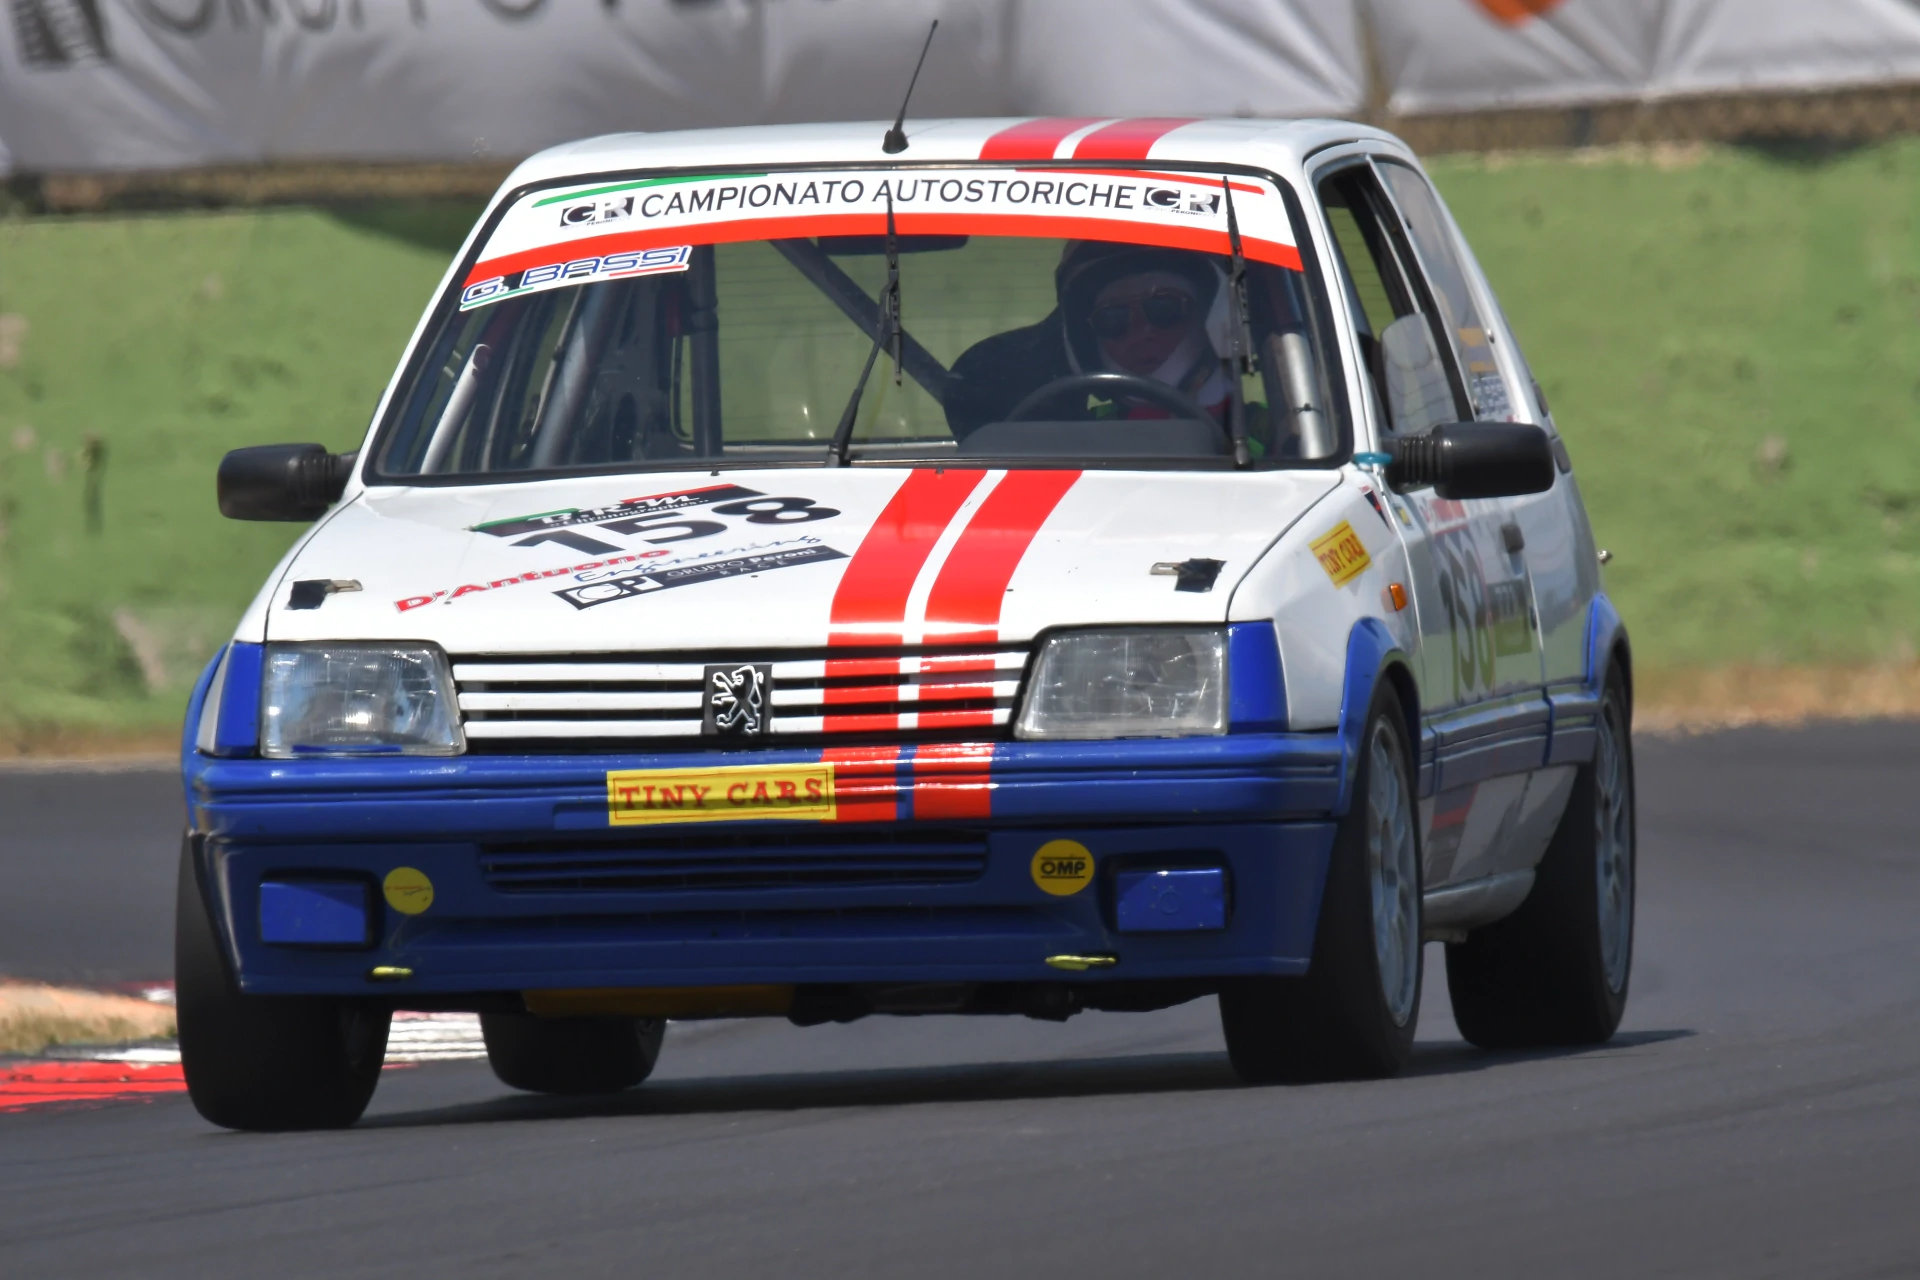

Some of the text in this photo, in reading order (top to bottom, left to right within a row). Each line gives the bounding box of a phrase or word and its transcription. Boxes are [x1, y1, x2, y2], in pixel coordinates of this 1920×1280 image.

[641, 179, 1138, 218] CAMPIONATO AUTOSTORICHE
[521, 246, 690, 287] BASSI
[509, 496, 842, 557] 158
[573, 535, 822, 583] Engineering
[665, 548, 817, 579] GRUPPO Peroni
[718, 559, 790, 577] RACE
[394, 549, 674, 613] D'Antuono
[618, 777, 823, 811] TINY CARS
[1040, 860, 1087, 876] OMP
